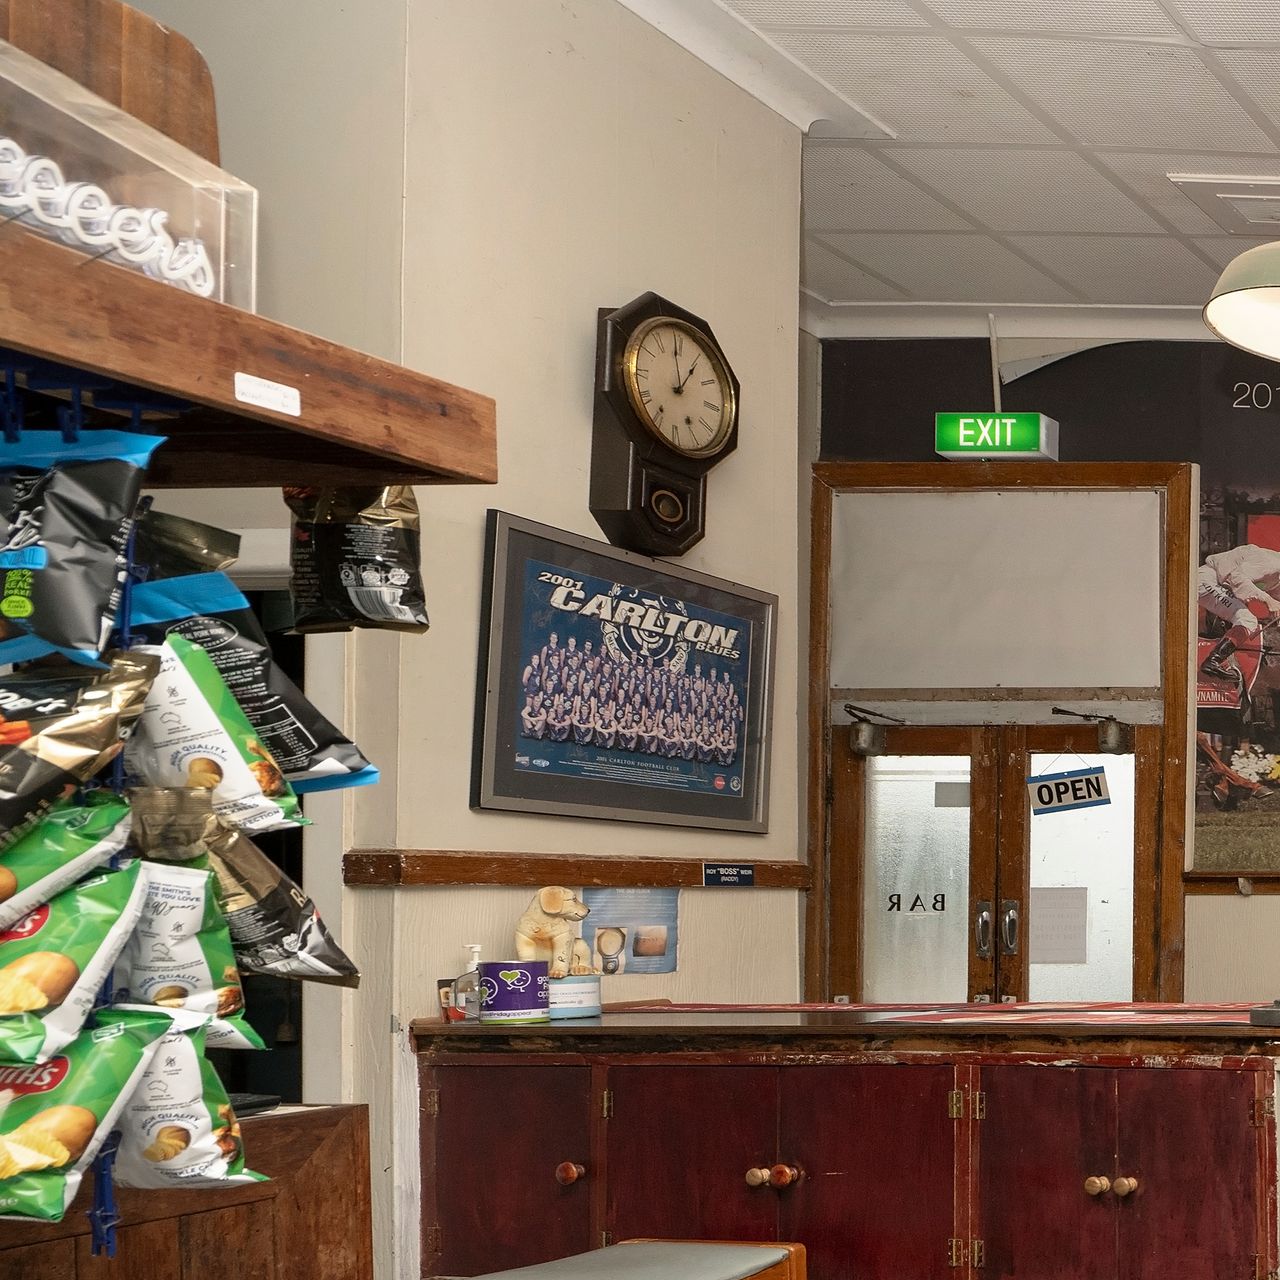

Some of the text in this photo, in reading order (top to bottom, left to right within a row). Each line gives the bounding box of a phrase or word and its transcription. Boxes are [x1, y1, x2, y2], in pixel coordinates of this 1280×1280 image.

[958, 418, 1017, 447] EXIT
[537, 571, 585, 590] 2001
[550, 586, 739, 648] CARLTON
[695, 641, 741, 660] BLUES
[182, 744, 228, 755] QUALITY
[608, 757, 636, 767] CARLTON
[637, 760, 665, 770] FOOTBALL
[666, 764, 681, 772] CLUB
[1036, 775, 1104, 806] OPEN
[162, 886, 191, 896] SMITH'S
[151, 901, 166, 915] 90
[158, 973, 202, 983] QUALITY
[157, 1112, 200, 1123] QUALITY
